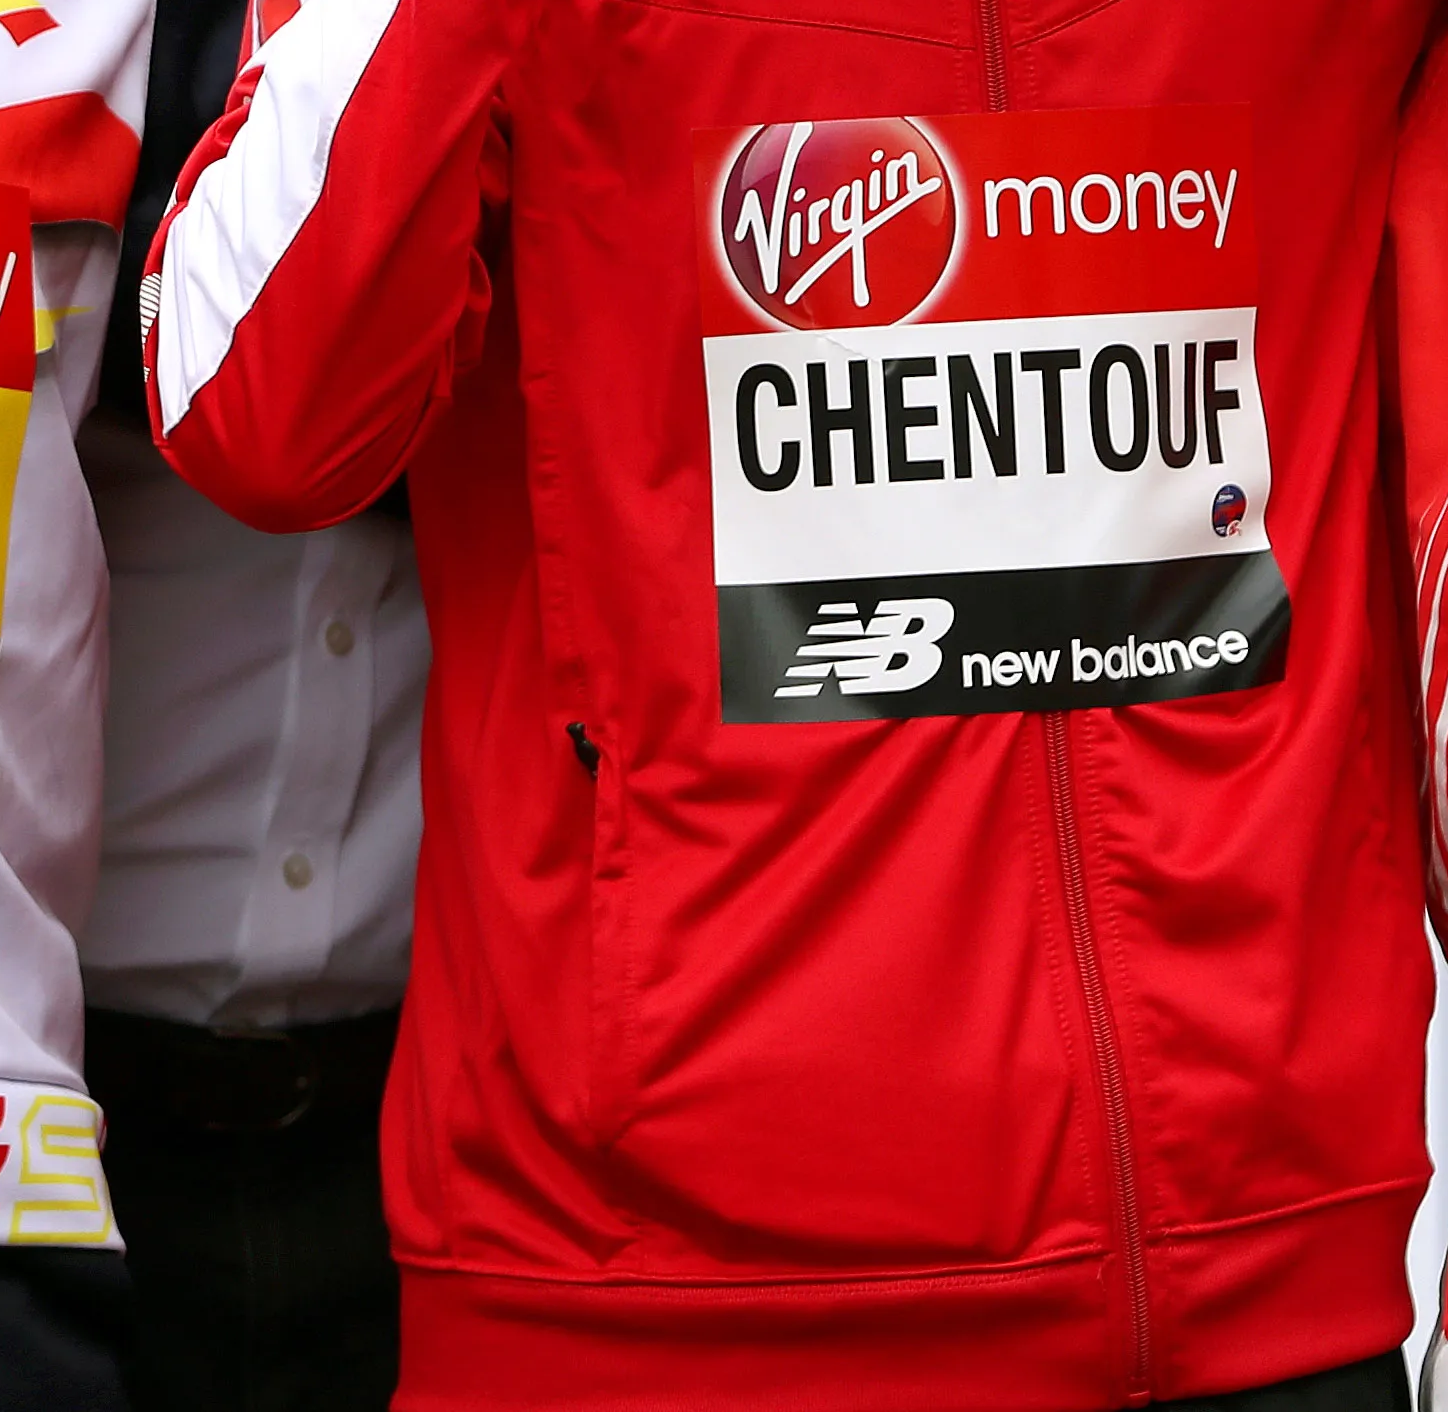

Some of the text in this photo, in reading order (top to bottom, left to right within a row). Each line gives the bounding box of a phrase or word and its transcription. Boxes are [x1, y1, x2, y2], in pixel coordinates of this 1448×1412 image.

[734, 121, 1238, 308] Virgin money
[735, 339, 1242, 493] CHENTOUF
[961, 648, 1062, 689] new
[1070, 627, 1250, 684] balance
